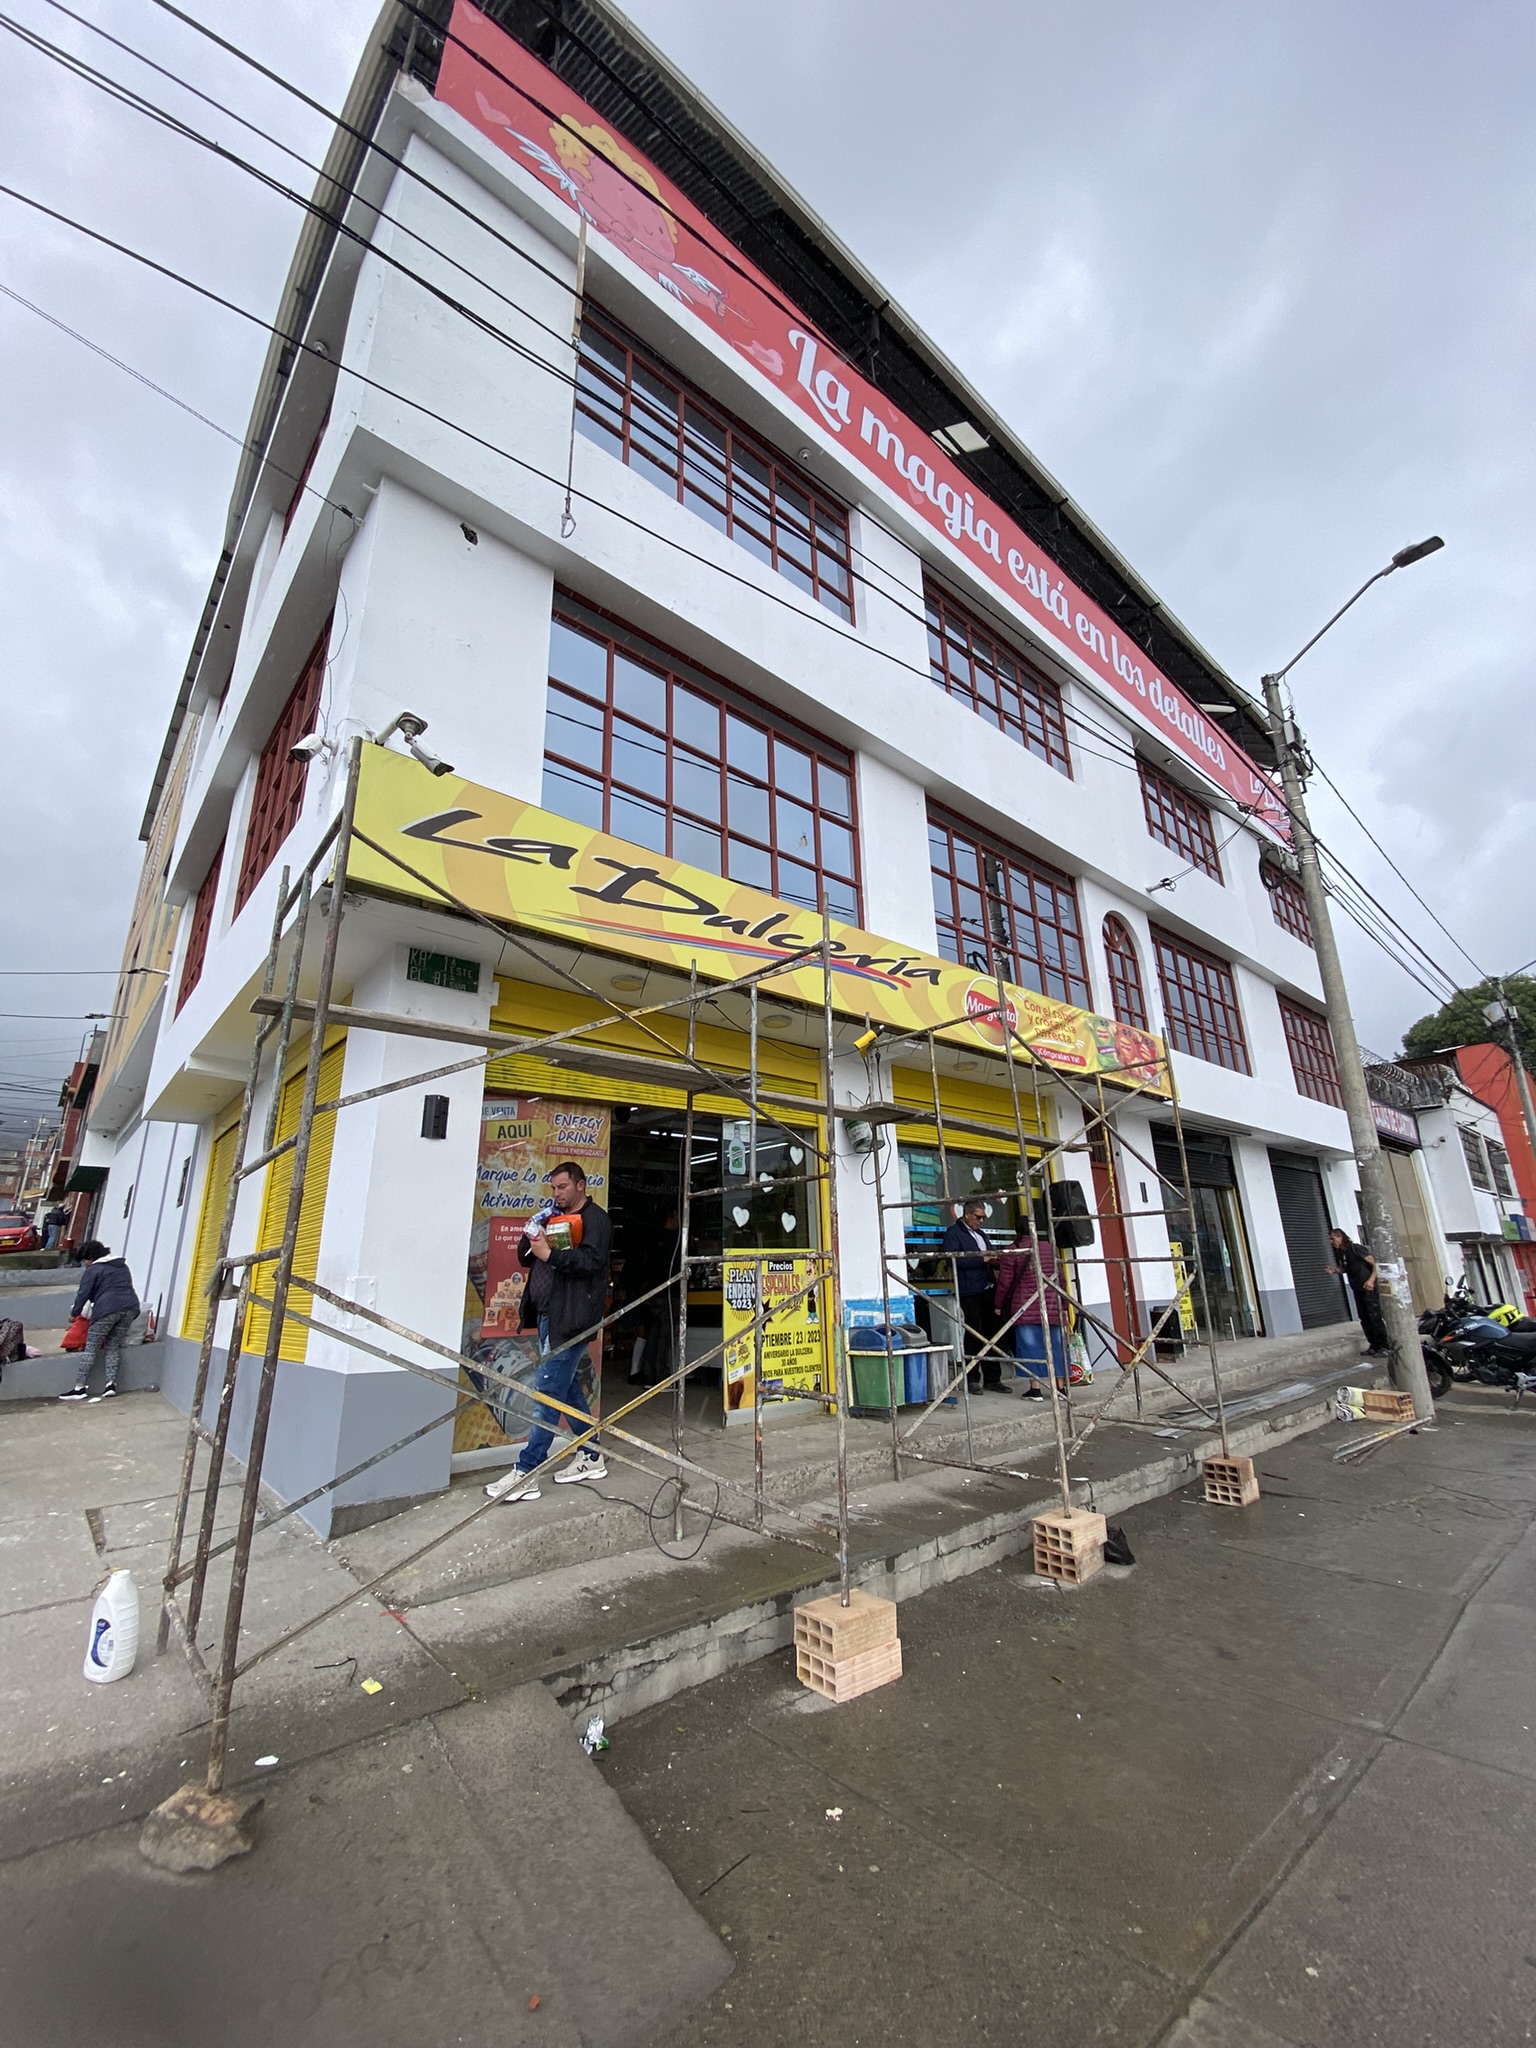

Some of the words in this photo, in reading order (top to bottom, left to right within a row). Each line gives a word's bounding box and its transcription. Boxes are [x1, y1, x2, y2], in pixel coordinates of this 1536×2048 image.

[788, 329, 851, 433] La
[860, 406, 1002, 564] magia
[1008, 548, 1072, 629] está
[1075, 612, 1109, 663] en
[1110, 634, 1147, 697] los
[1149, 677, 1227, 771] detalles
[398, 806, 581, 871] La
[1023, 999, 1042, 1014] Con
[1042, 1006, 1051, 1017] el
[1052, 1010, 1076, 1024] sabor
[1027, 1014, 1034, 1025] y
[491, 1106, 516, 1116] VENTA
[497, 1121, 533, 1139] AQUÍ
[554, 1113, 604, 1131] ENERGY
[557, 1129, 599, 1145] DRINK
[522, 1167, 537, 1183] la
[481, 1191, 535, 1209] Activate
[768, 1261, 793, 1271] Precios
[729, 1269, 756, 1282] PLAN
[724, 1282, 756, 1299] TENDERO
[731, 1299, 752, 1309] 2023
[796, 1331, 803, 1345] 23
[807, 1329, 821, 1344] 2023
[764, 1349, 789, 1359] ANIVERSARIO
[789, 1348, 795, 1357] LA
[773, 1368, 784, 1377] PARA
